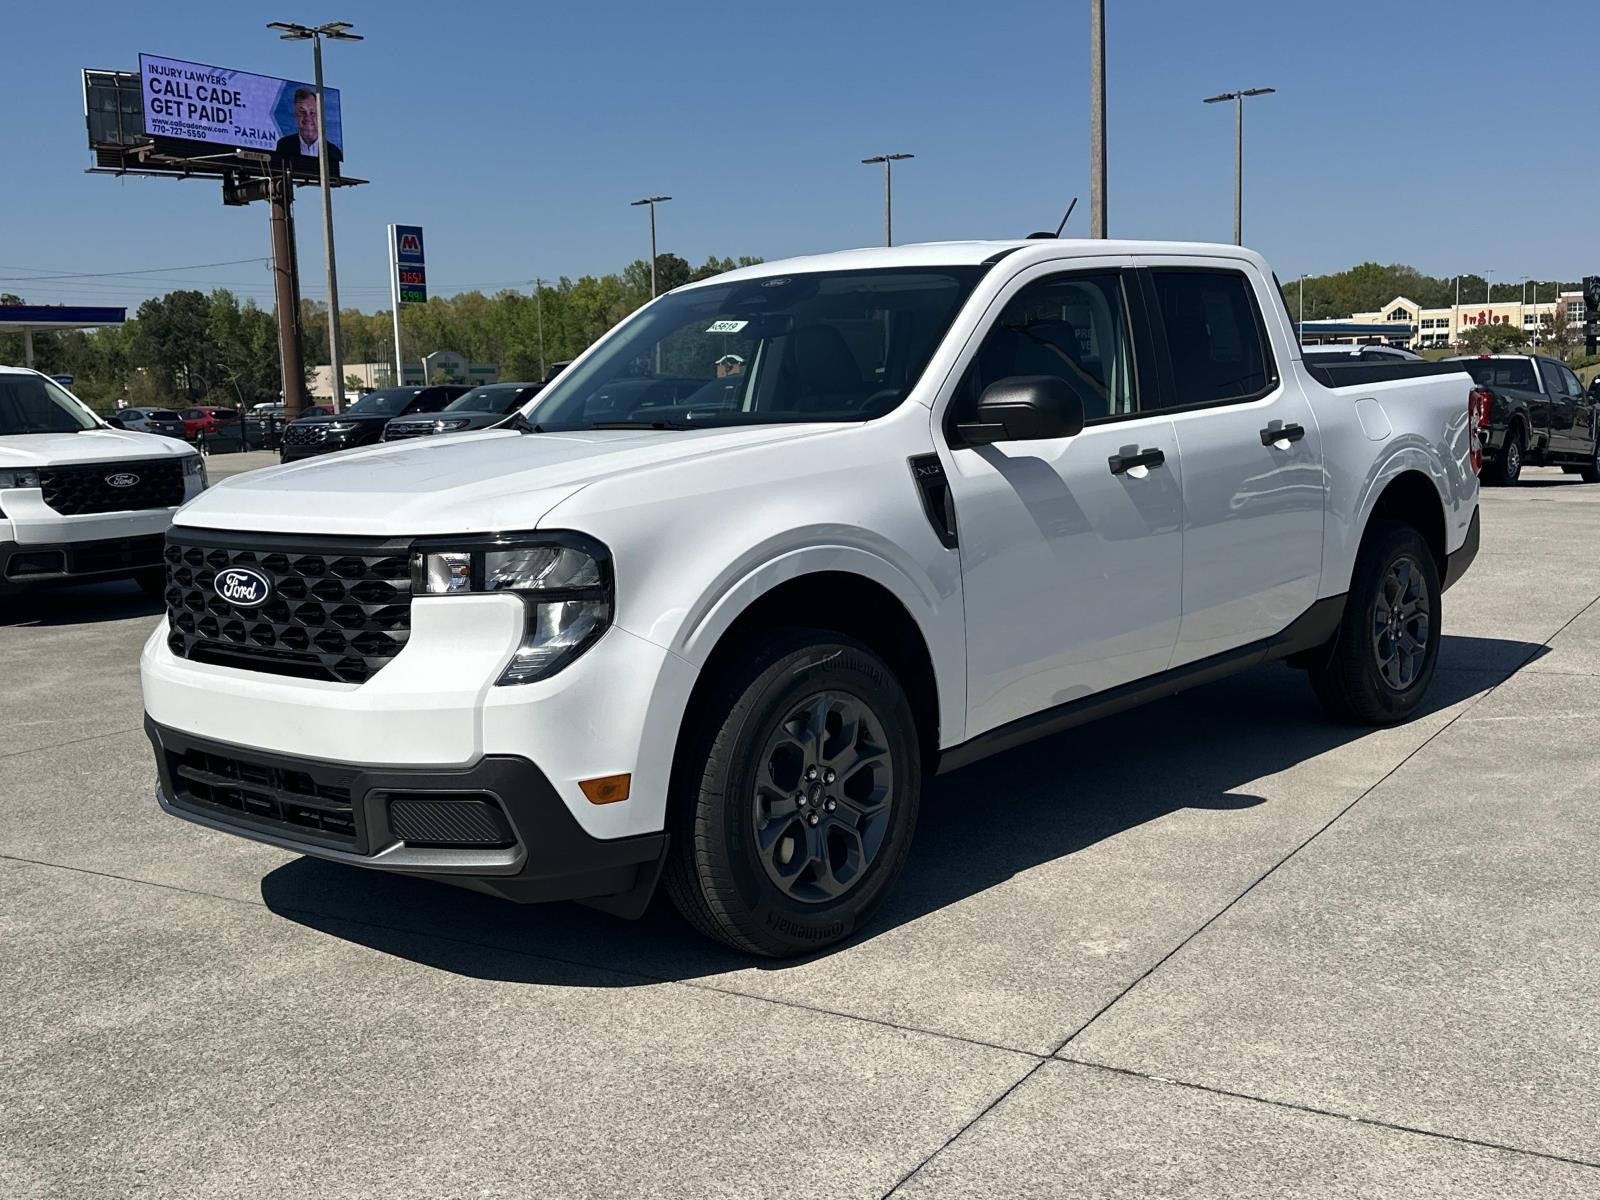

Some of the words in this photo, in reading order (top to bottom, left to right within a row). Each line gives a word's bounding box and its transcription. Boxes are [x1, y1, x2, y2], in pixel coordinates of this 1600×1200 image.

[148, 64, 183, 78] INJURY
[184, 70, 227, 86] LAWYERS
[149, 77, 193, 100] CALL
[196, 85, 247, 108] CADE.
[150, 97, 183, 117] GET
[187, 102, 233, 125] PAID!
[151, 118, 229, 134] www.callcadenow.com
[152, 124, 207, 139] 770-727-5550
[234, 125, 276, 142] PARIAN
[113, 474, 135, 486] Ford
[223, 573, 258, 600] Ford
